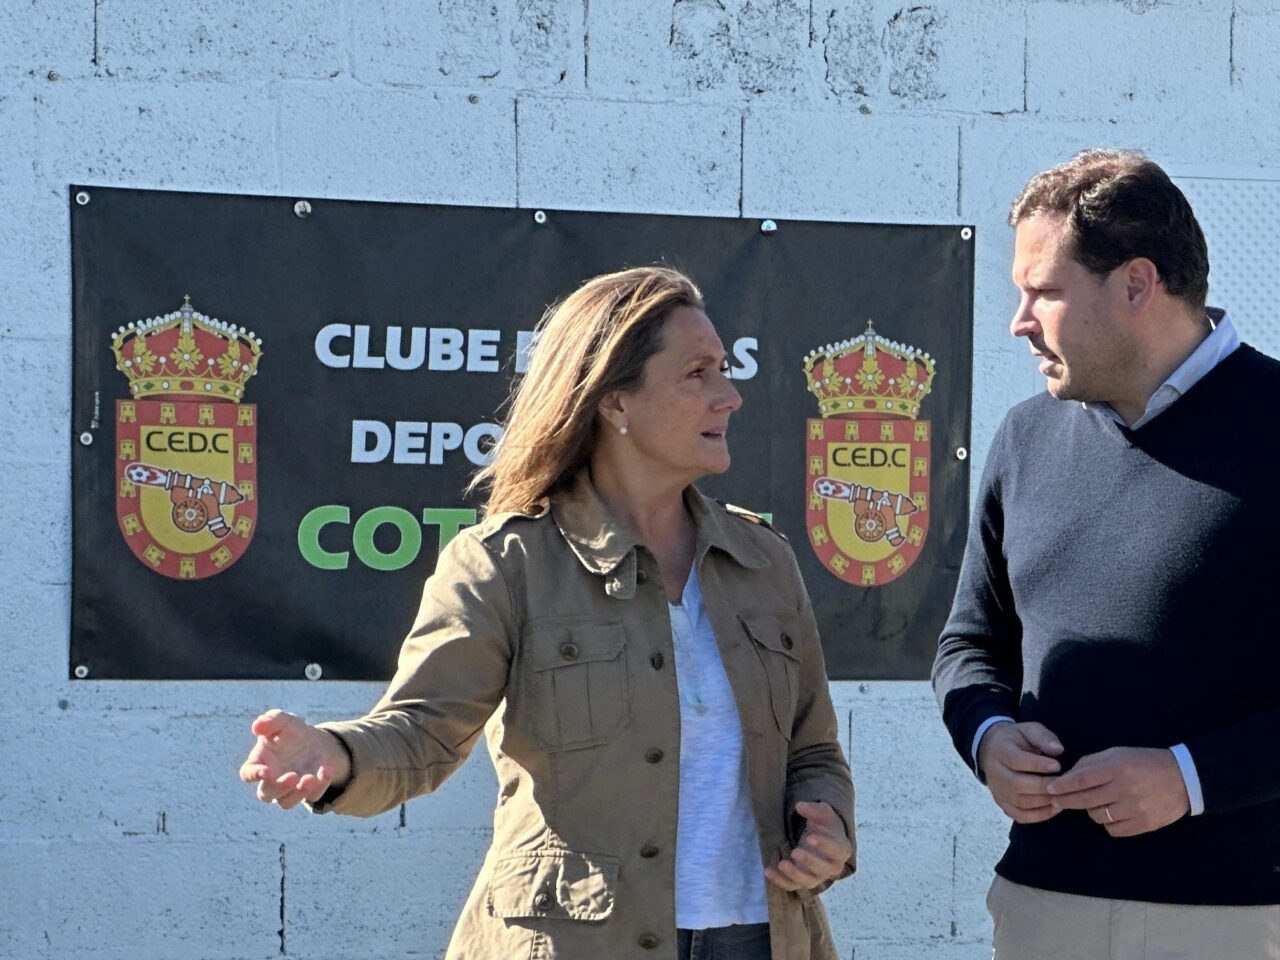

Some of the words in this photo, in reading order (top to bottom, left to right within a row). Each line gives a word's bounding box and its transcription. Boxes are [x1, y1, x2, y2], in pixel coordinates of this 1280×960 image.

[314, 323, 501, 373] CLUBE
[351, 419, 505, 466] DEPO
[298, 505, 477, 571] COT
